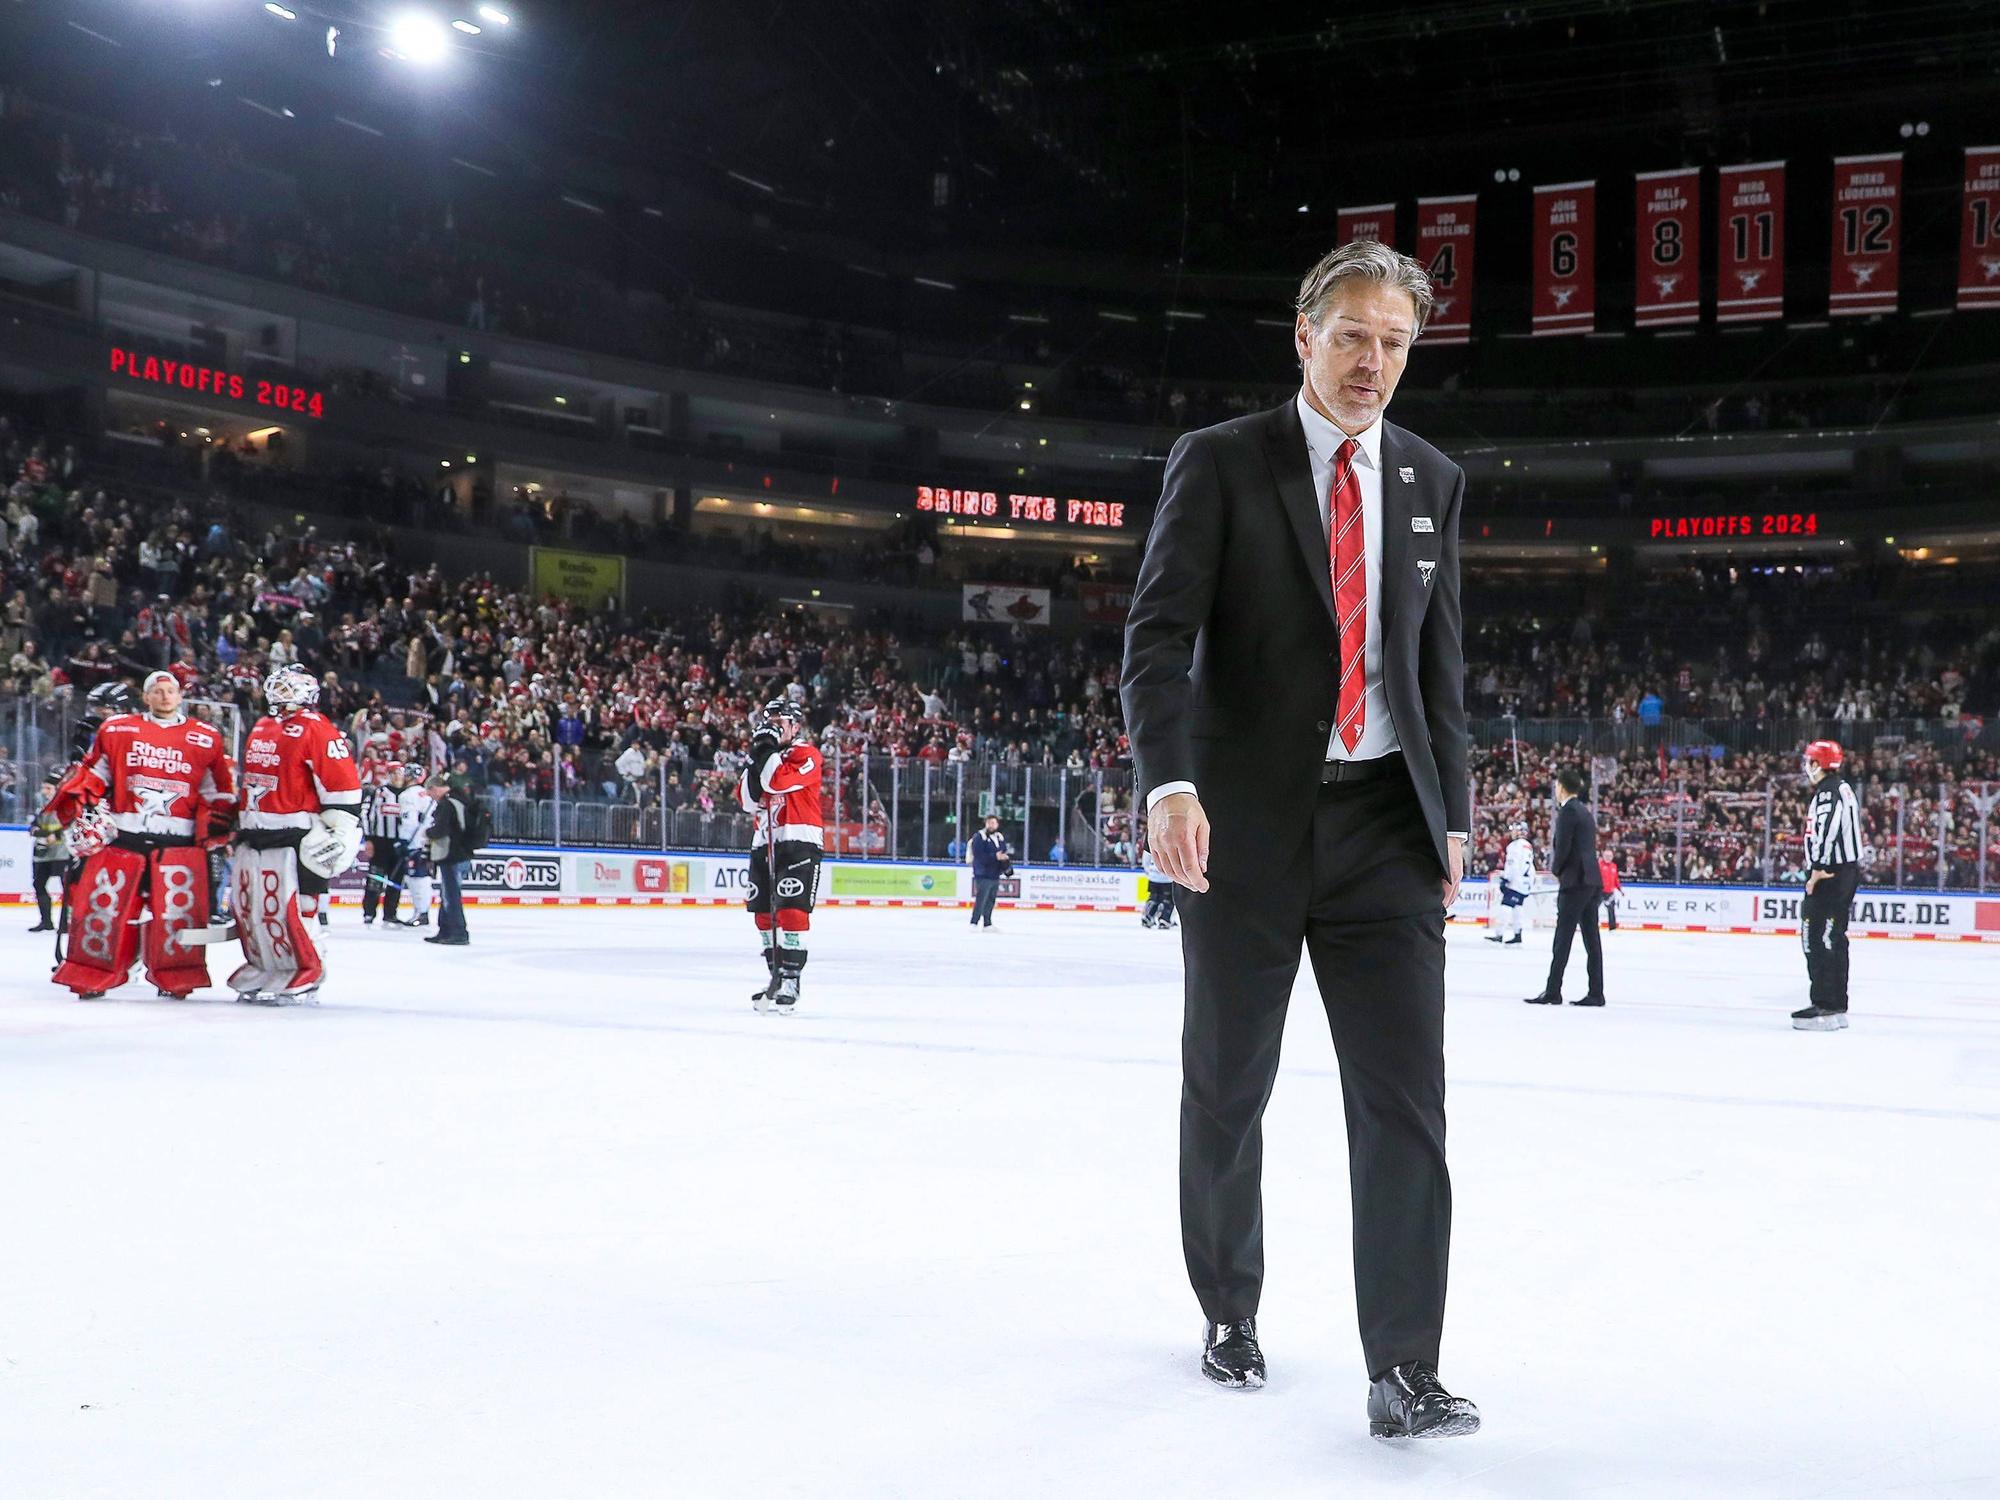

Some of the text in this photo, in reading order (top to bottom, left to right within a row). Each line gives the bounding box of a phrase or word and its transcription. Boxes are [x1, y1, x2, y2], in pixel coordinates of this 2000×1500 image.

[1652, 218, 1683, 266] 8
[1730, 212, 1774, 262] 11
[1840, 204, 1893, 256] 12
[1430, 243, 1457, 289] 4
[1550, 231, 1578, 278] 6
[110, 348, 324, 418] PLAYOFFS 2024
[916, 486, 1125, 527] BRING THE FIRE
[1651, 513, 1817, 538] PLAYOFFS 2024
[132, 740, 183, 761] Rhein
[327, 738, 349, 760] 45
[126, 752, 192, 775] Energie
[641, 864, 663, 878] Time
[644, 878, 660, 888] out
[1030, 873, 1120, 885] erdmann@axis.de
[1457, 888, 1488, 902] Karri
